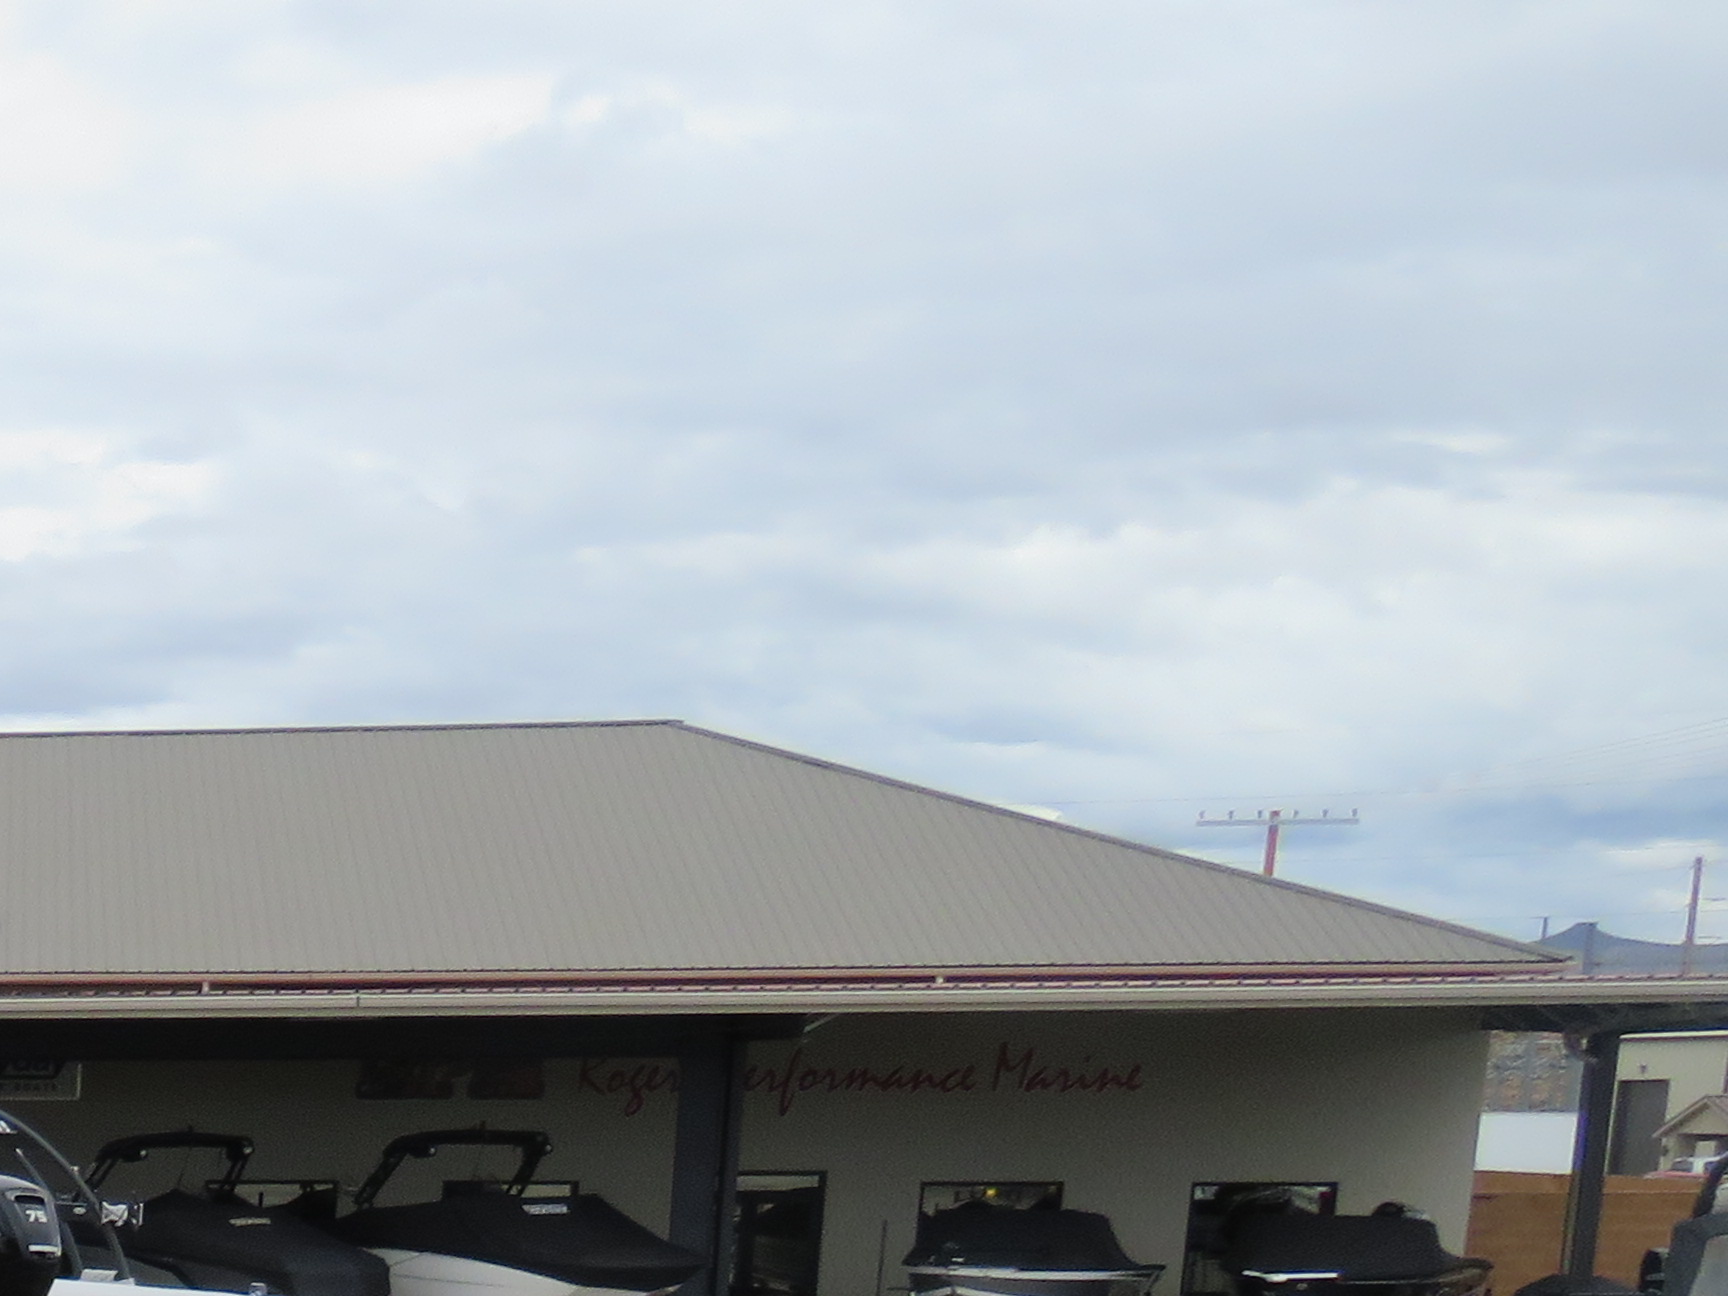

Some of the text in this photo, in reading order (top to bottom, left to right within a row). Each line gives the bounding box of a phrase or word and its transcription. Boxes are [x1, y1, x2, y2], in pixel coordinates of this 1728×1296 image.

[744, 1047, 975, 1116] erformance
[992, 1042, 1143, 1093] Marine
[25, 1210, 47, 1223] 75
